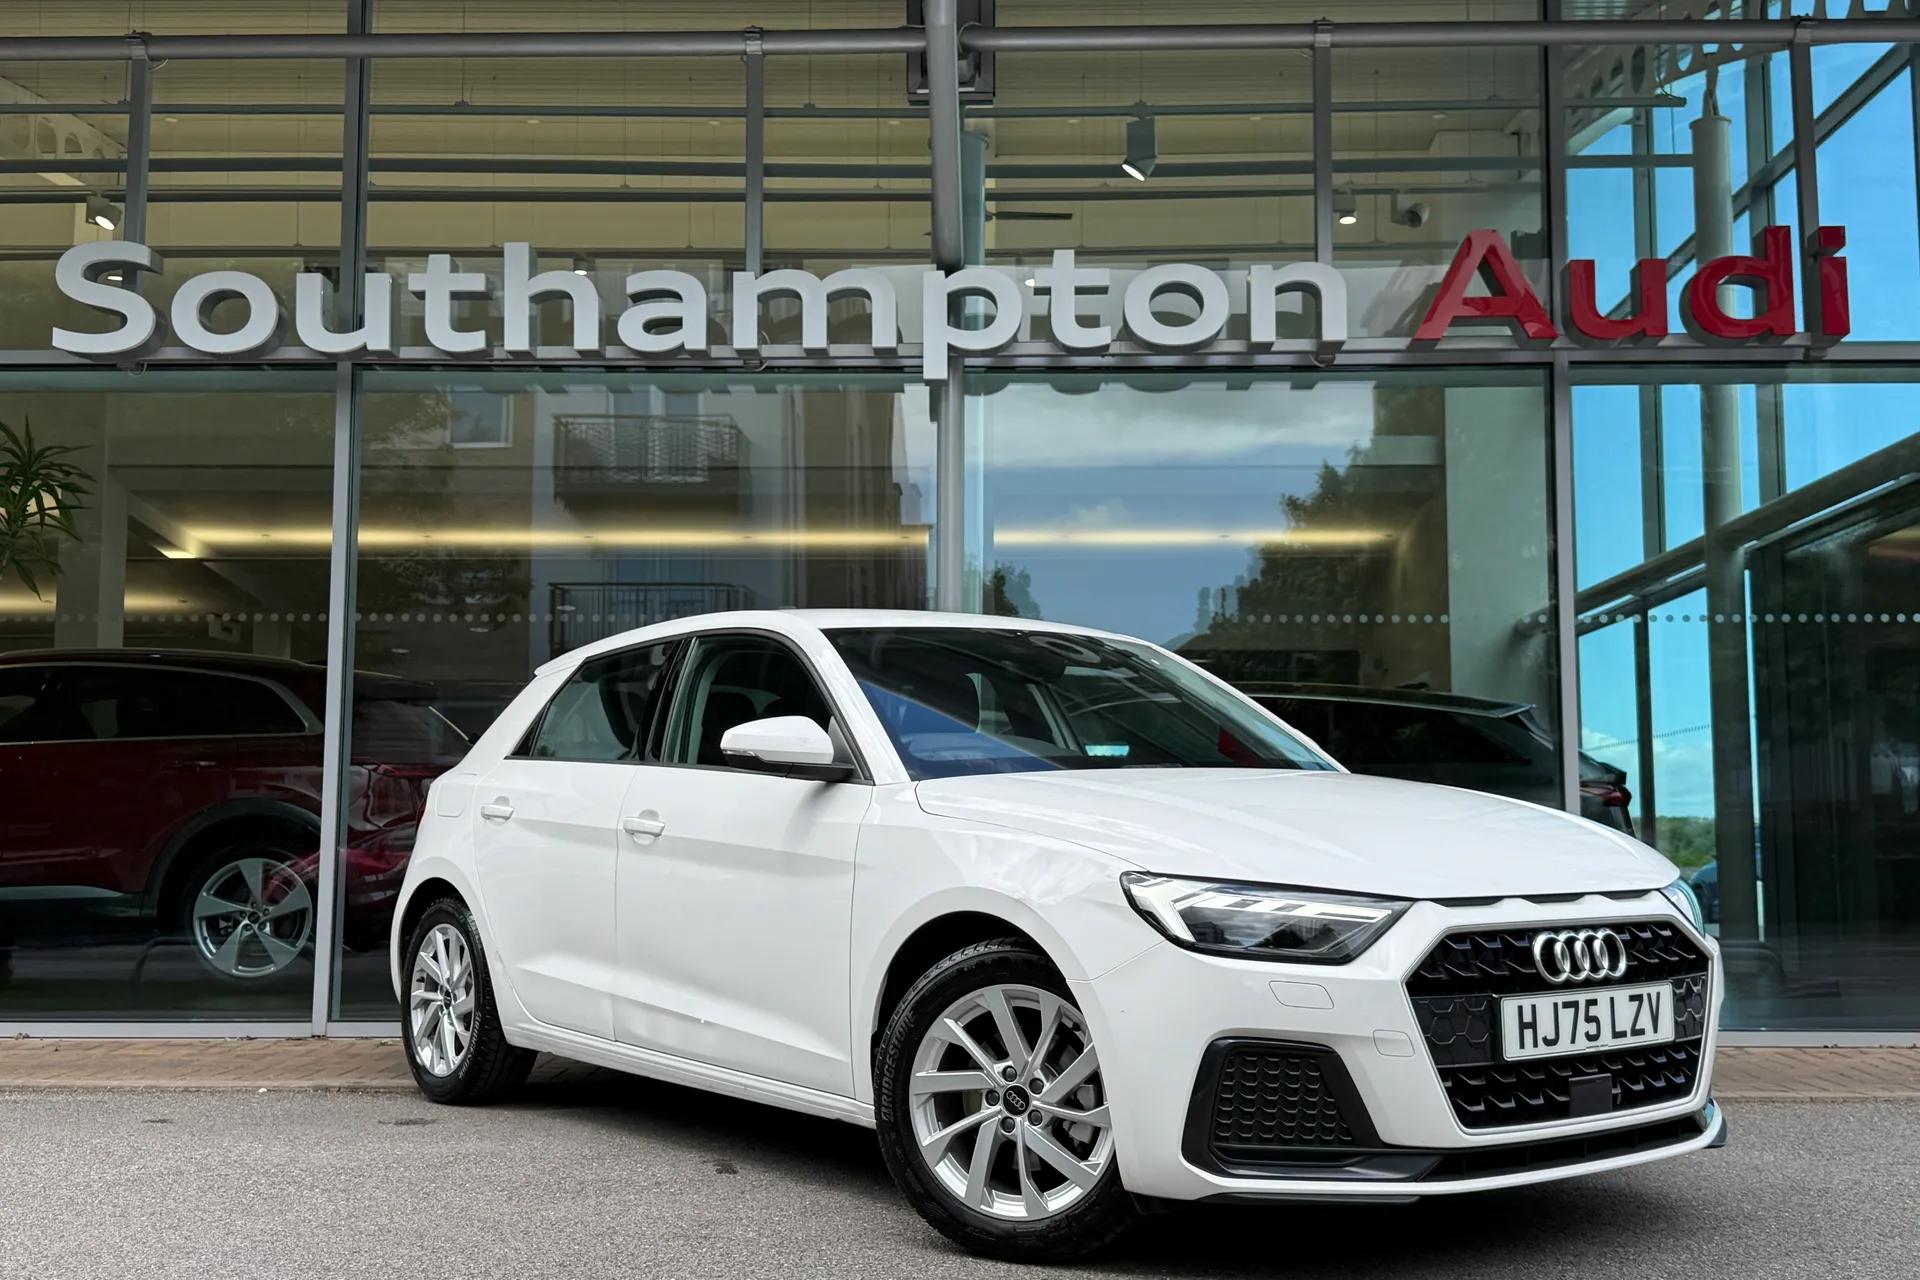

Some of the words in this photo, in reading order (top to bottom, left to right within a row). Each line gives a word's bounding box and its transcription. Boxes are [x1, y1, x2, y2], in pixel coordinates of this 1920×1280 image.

[51, 239, 1349, 381] Southampton
[1414, 225, 1851, 346] Audi
[1517, 999, 1601, 1050] HJ75
[1609, 991, 1661, 1040] LZV
